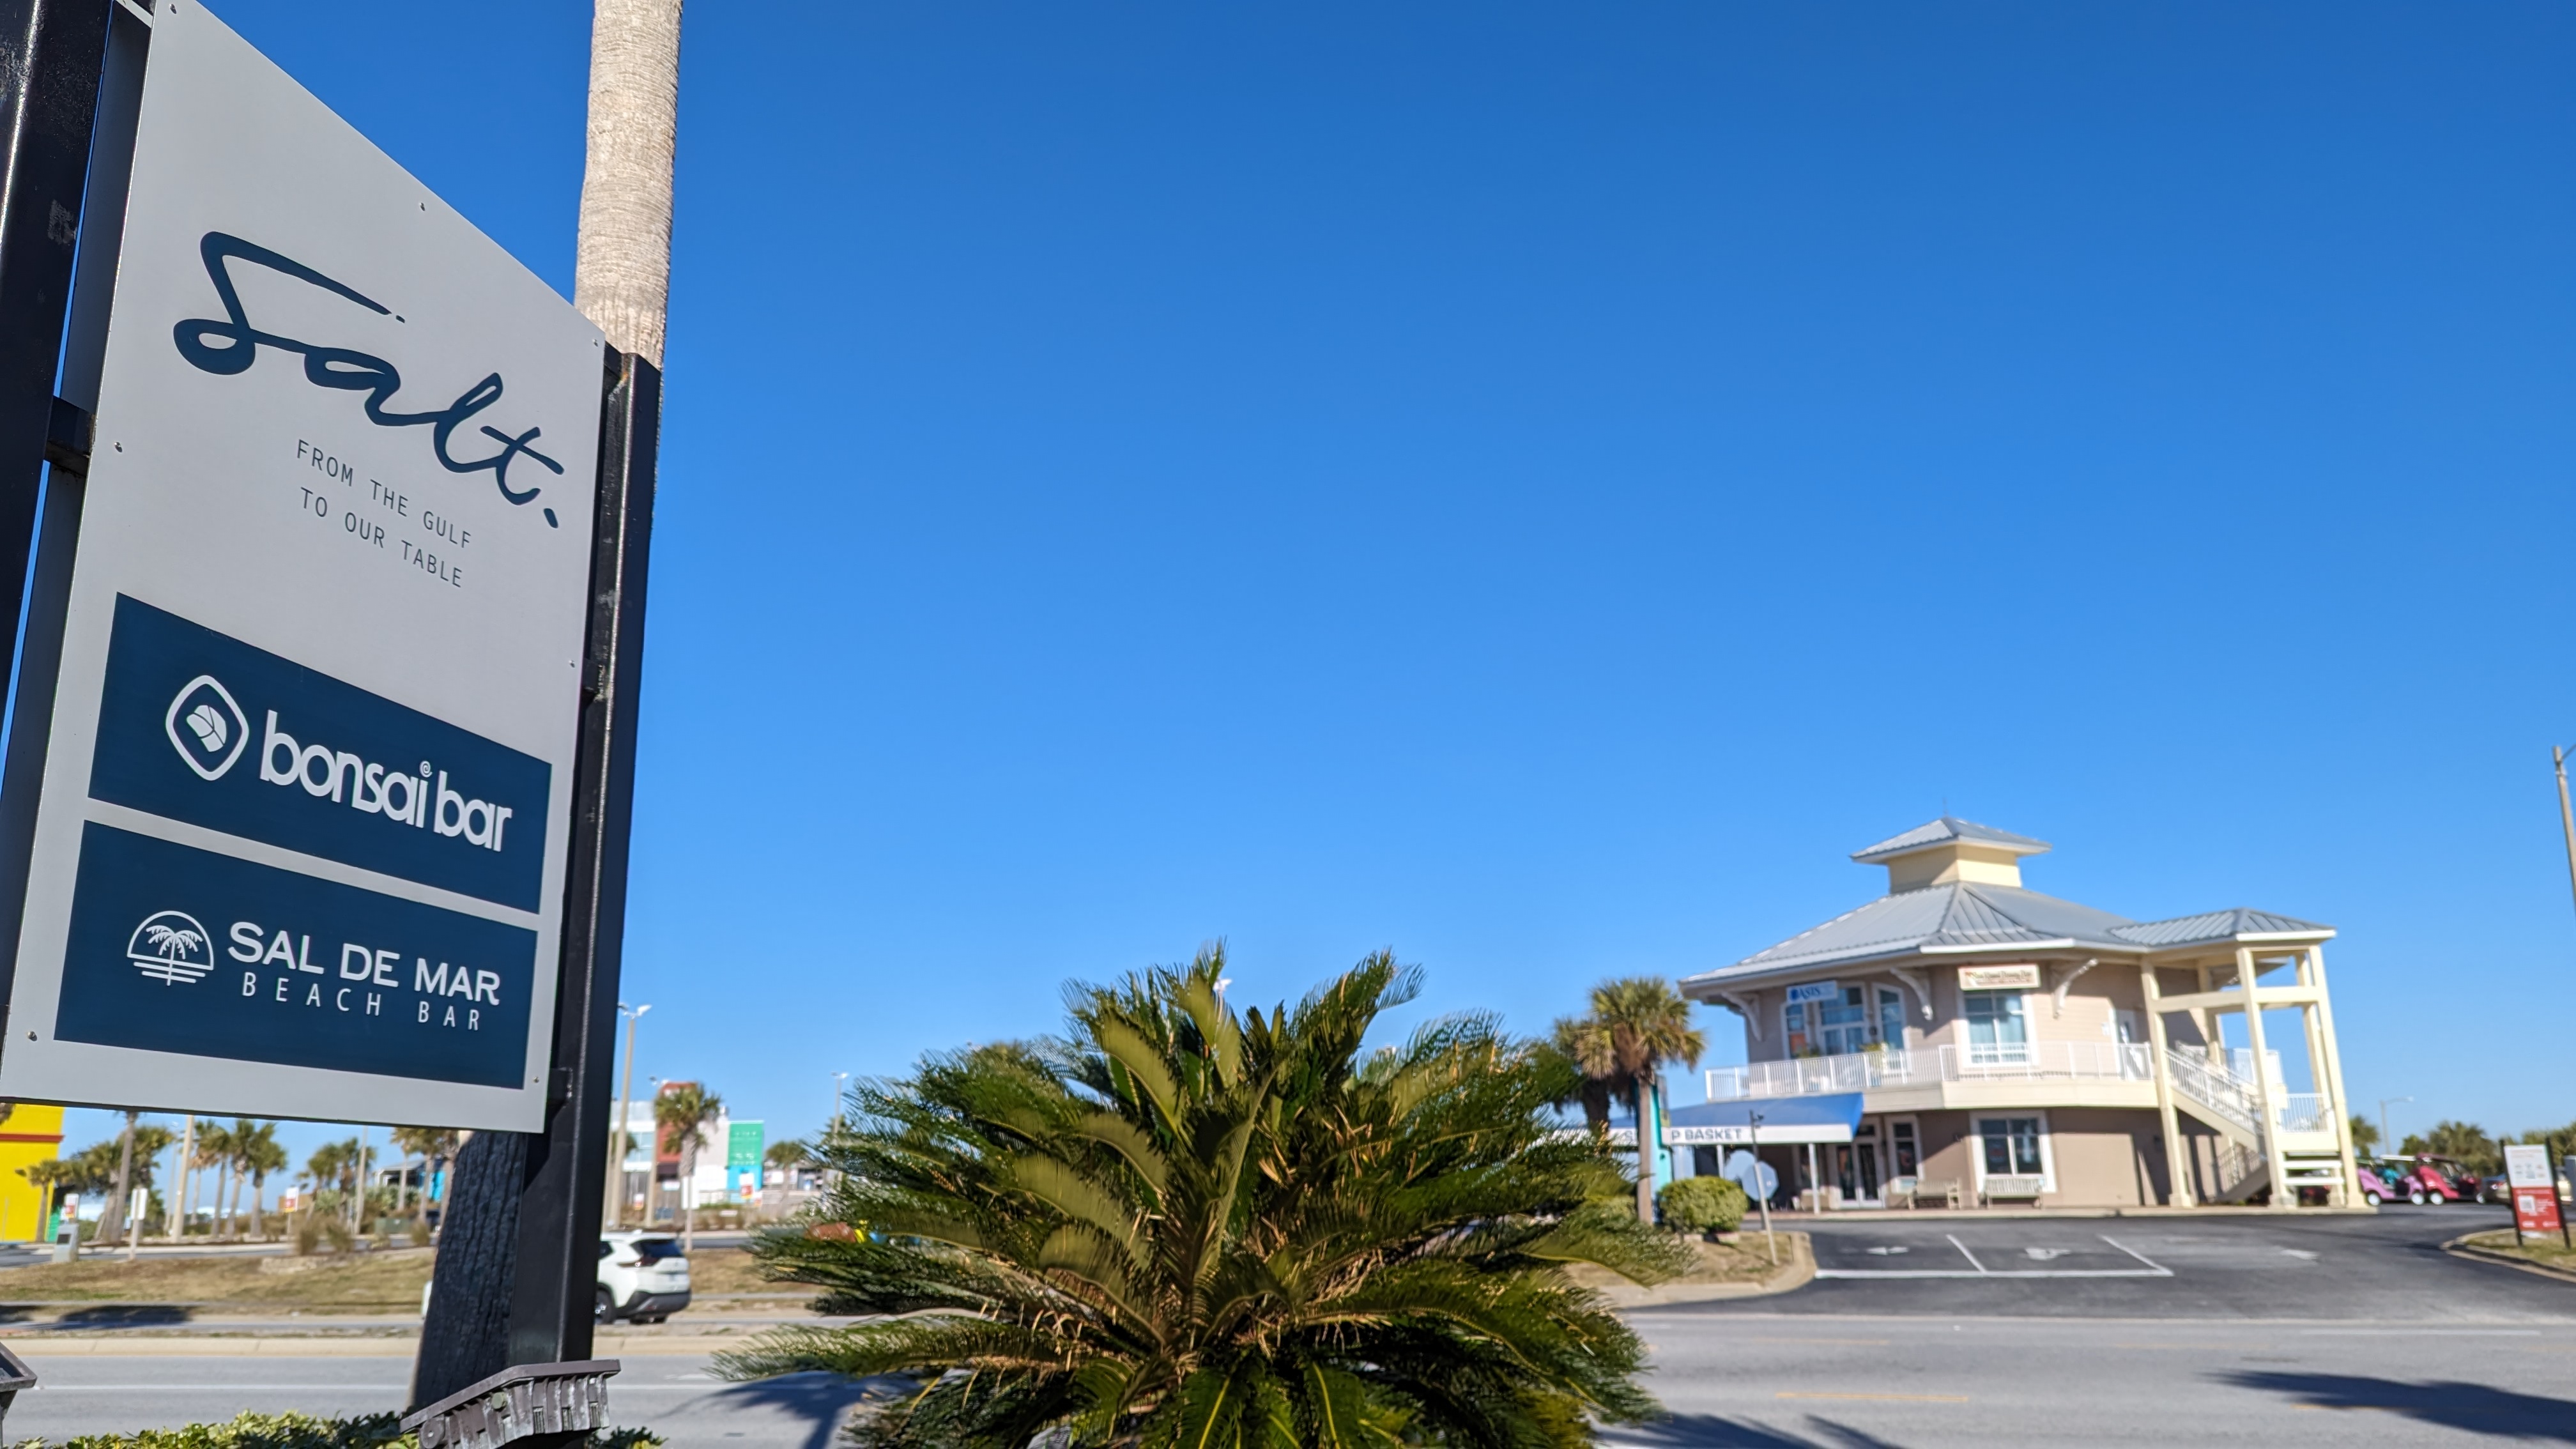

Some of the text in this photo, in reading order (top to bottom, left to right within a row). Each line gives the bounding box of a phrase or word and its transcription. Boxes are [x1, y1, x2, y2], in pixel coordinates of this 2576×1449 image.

[297, 439, 471, 548] FROM THE GULF
[300, 487, 463, 588] TO OUR TABLE
[259, 709, 513, 852] bonsai bar
[227, 921, 500, 1006] SAL DE MAR
[242, 971, 479, 1031] BEACH BAR
[1684, 1128, 1742, 1141] BASKET
